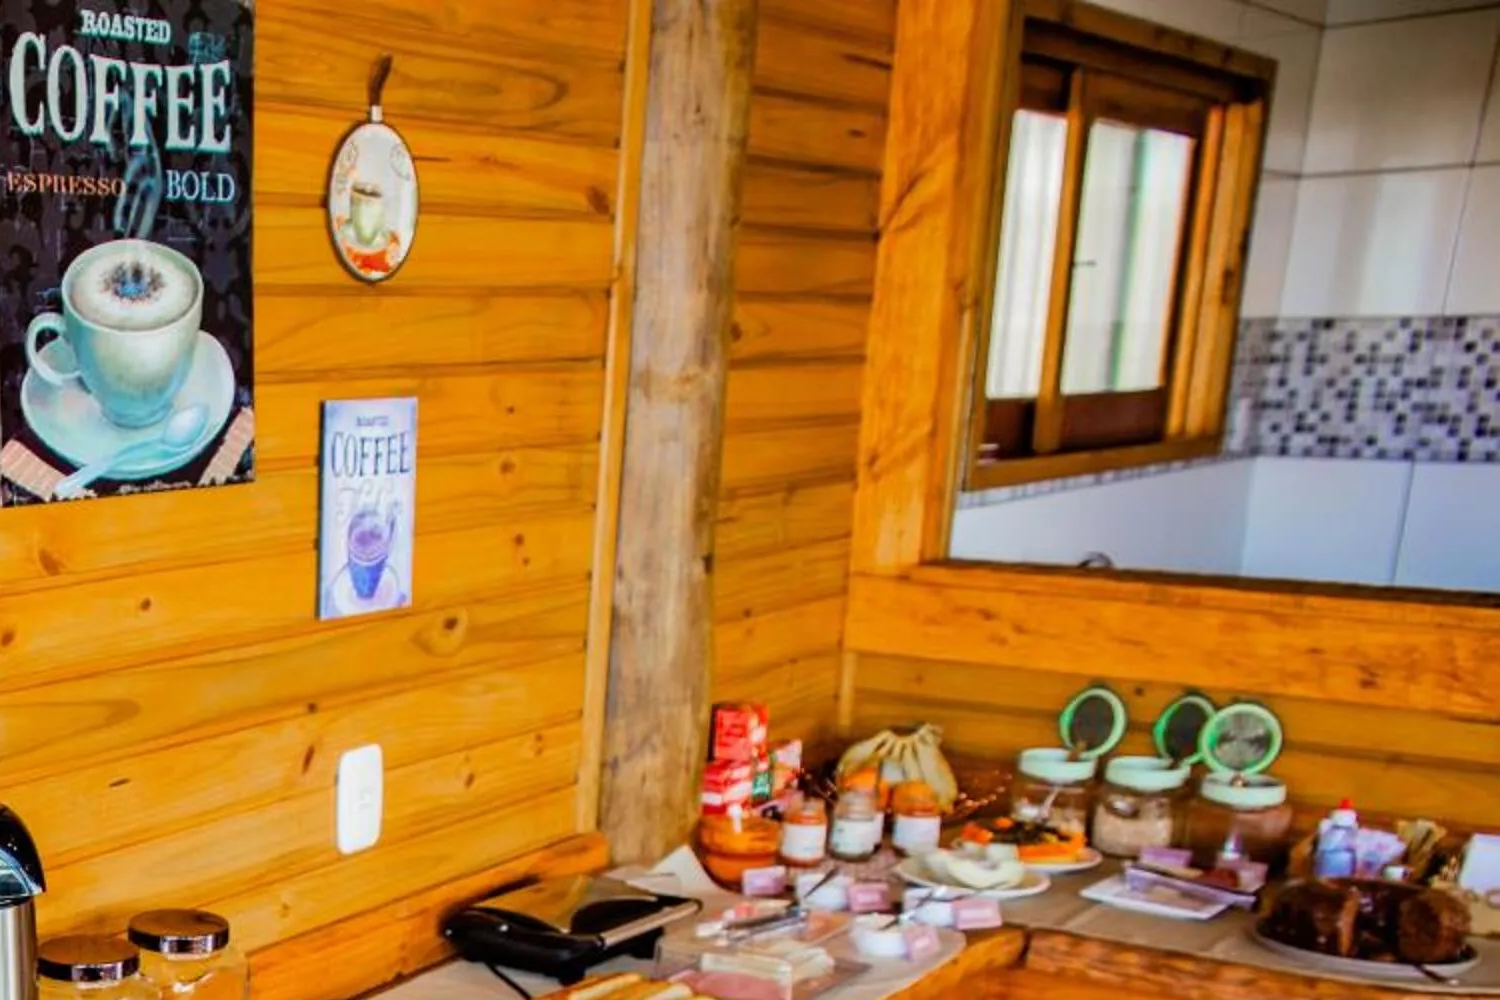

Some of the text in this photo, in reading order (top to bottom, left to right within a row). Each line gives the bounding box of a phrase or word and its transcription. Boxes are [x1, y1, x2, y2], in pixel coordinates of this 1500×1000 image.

[80, 9, 172, 45] ROASTED
[9, 31, 232, 152] COFFEE
[6, 169, 236, 202] ESPRESSO BOLD
[331, 431, 411, 478] COFFEE
